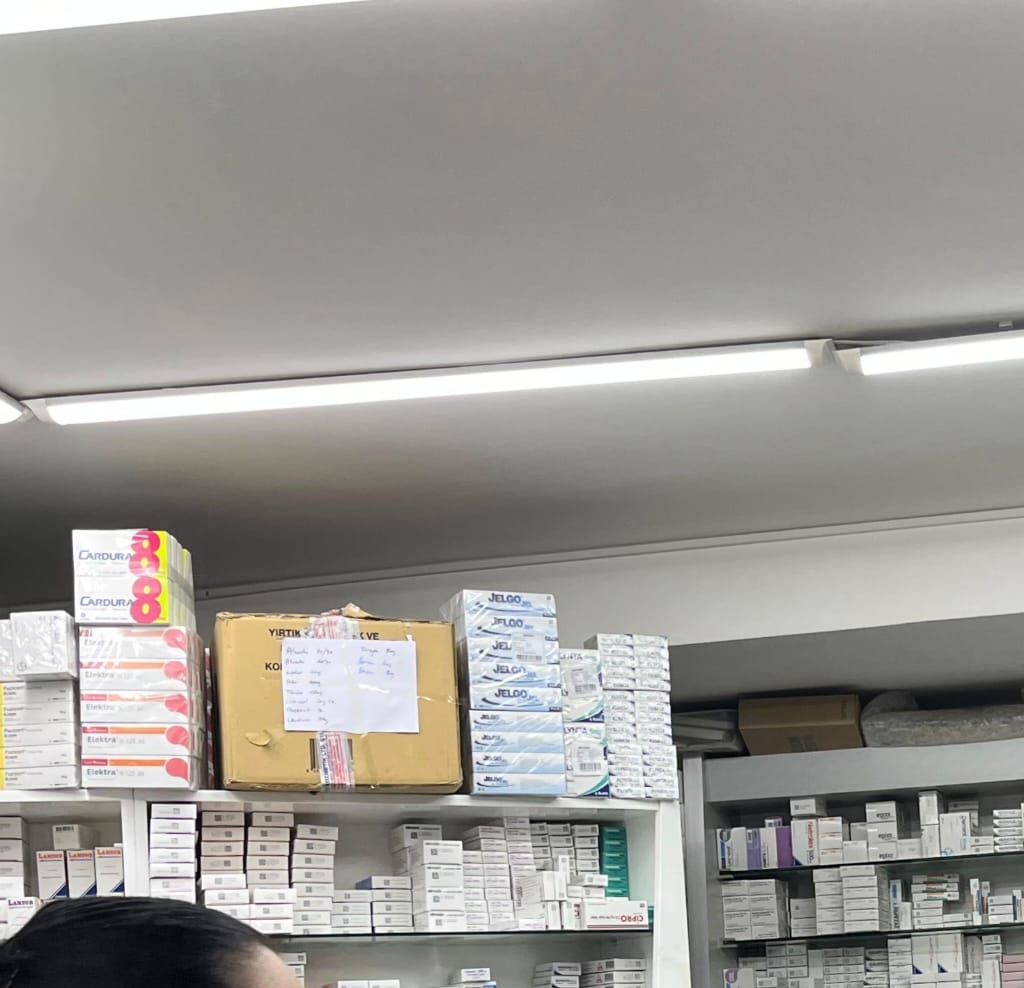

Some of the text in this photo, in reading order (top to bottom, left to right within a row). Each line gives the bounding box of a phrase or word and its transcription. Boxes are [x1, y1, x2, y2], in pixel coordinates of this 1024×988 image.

[80, 596, 134, 607] CARDURA
[488, 593, 521, 604] JELGO
[494, 688, 528, 699] JELGO
[87, 736, 116, 744] Elektra
[87, 768, 116, 776] Elektra
